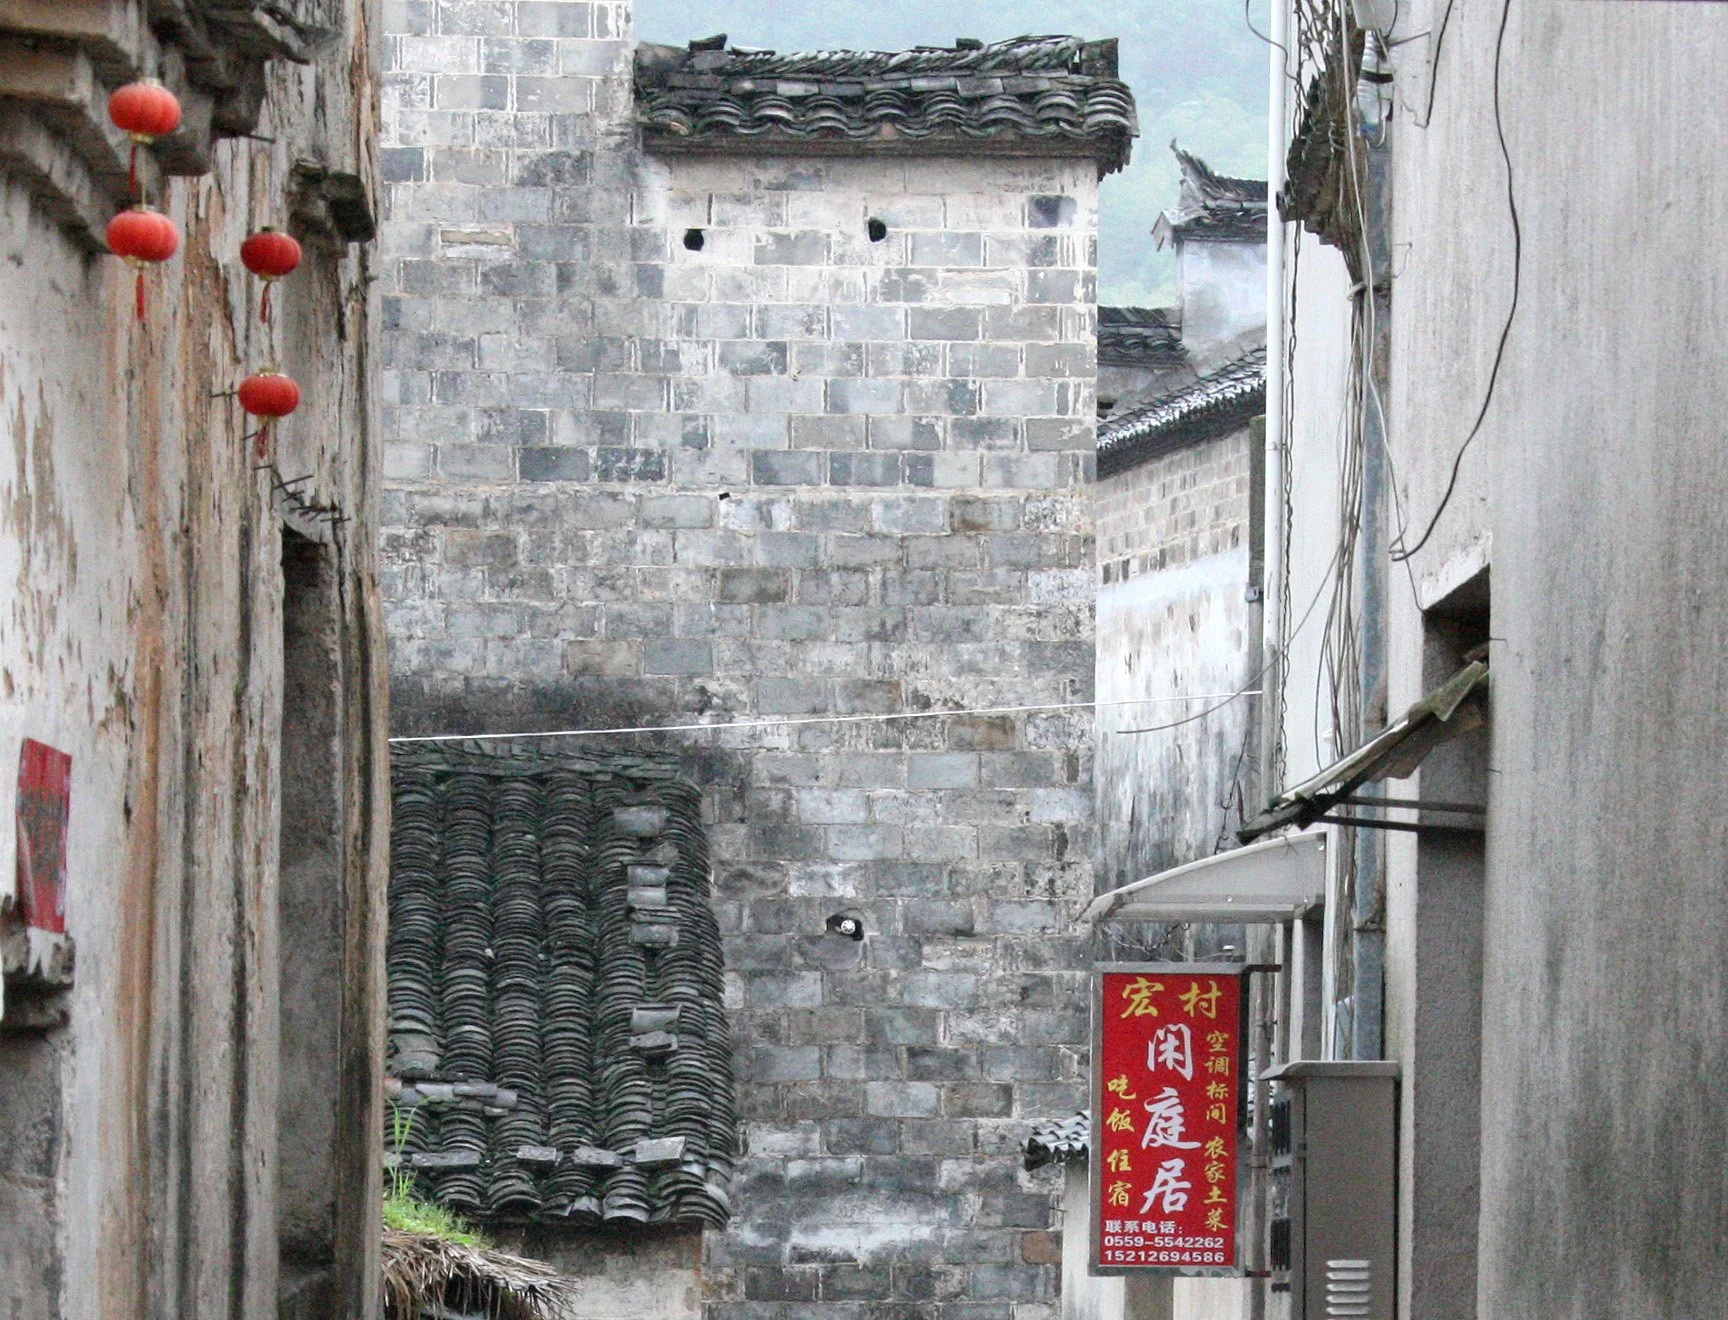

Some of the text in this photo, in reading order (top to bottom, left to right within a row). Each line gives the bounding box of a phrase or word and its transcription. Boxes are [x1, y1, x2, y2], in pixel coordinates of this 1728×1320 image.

[1121, 976, 1222, 1019] 宏村
[1106, 1074, 1137, 1207] 吃饭 住宿
[1204, 1031, 1230, 1232] 空调标间 农家土菜
[1104, 1235, 1224, 1249] 0559-5542262
[1105, 1250, 1225, 1263] 15212694586
